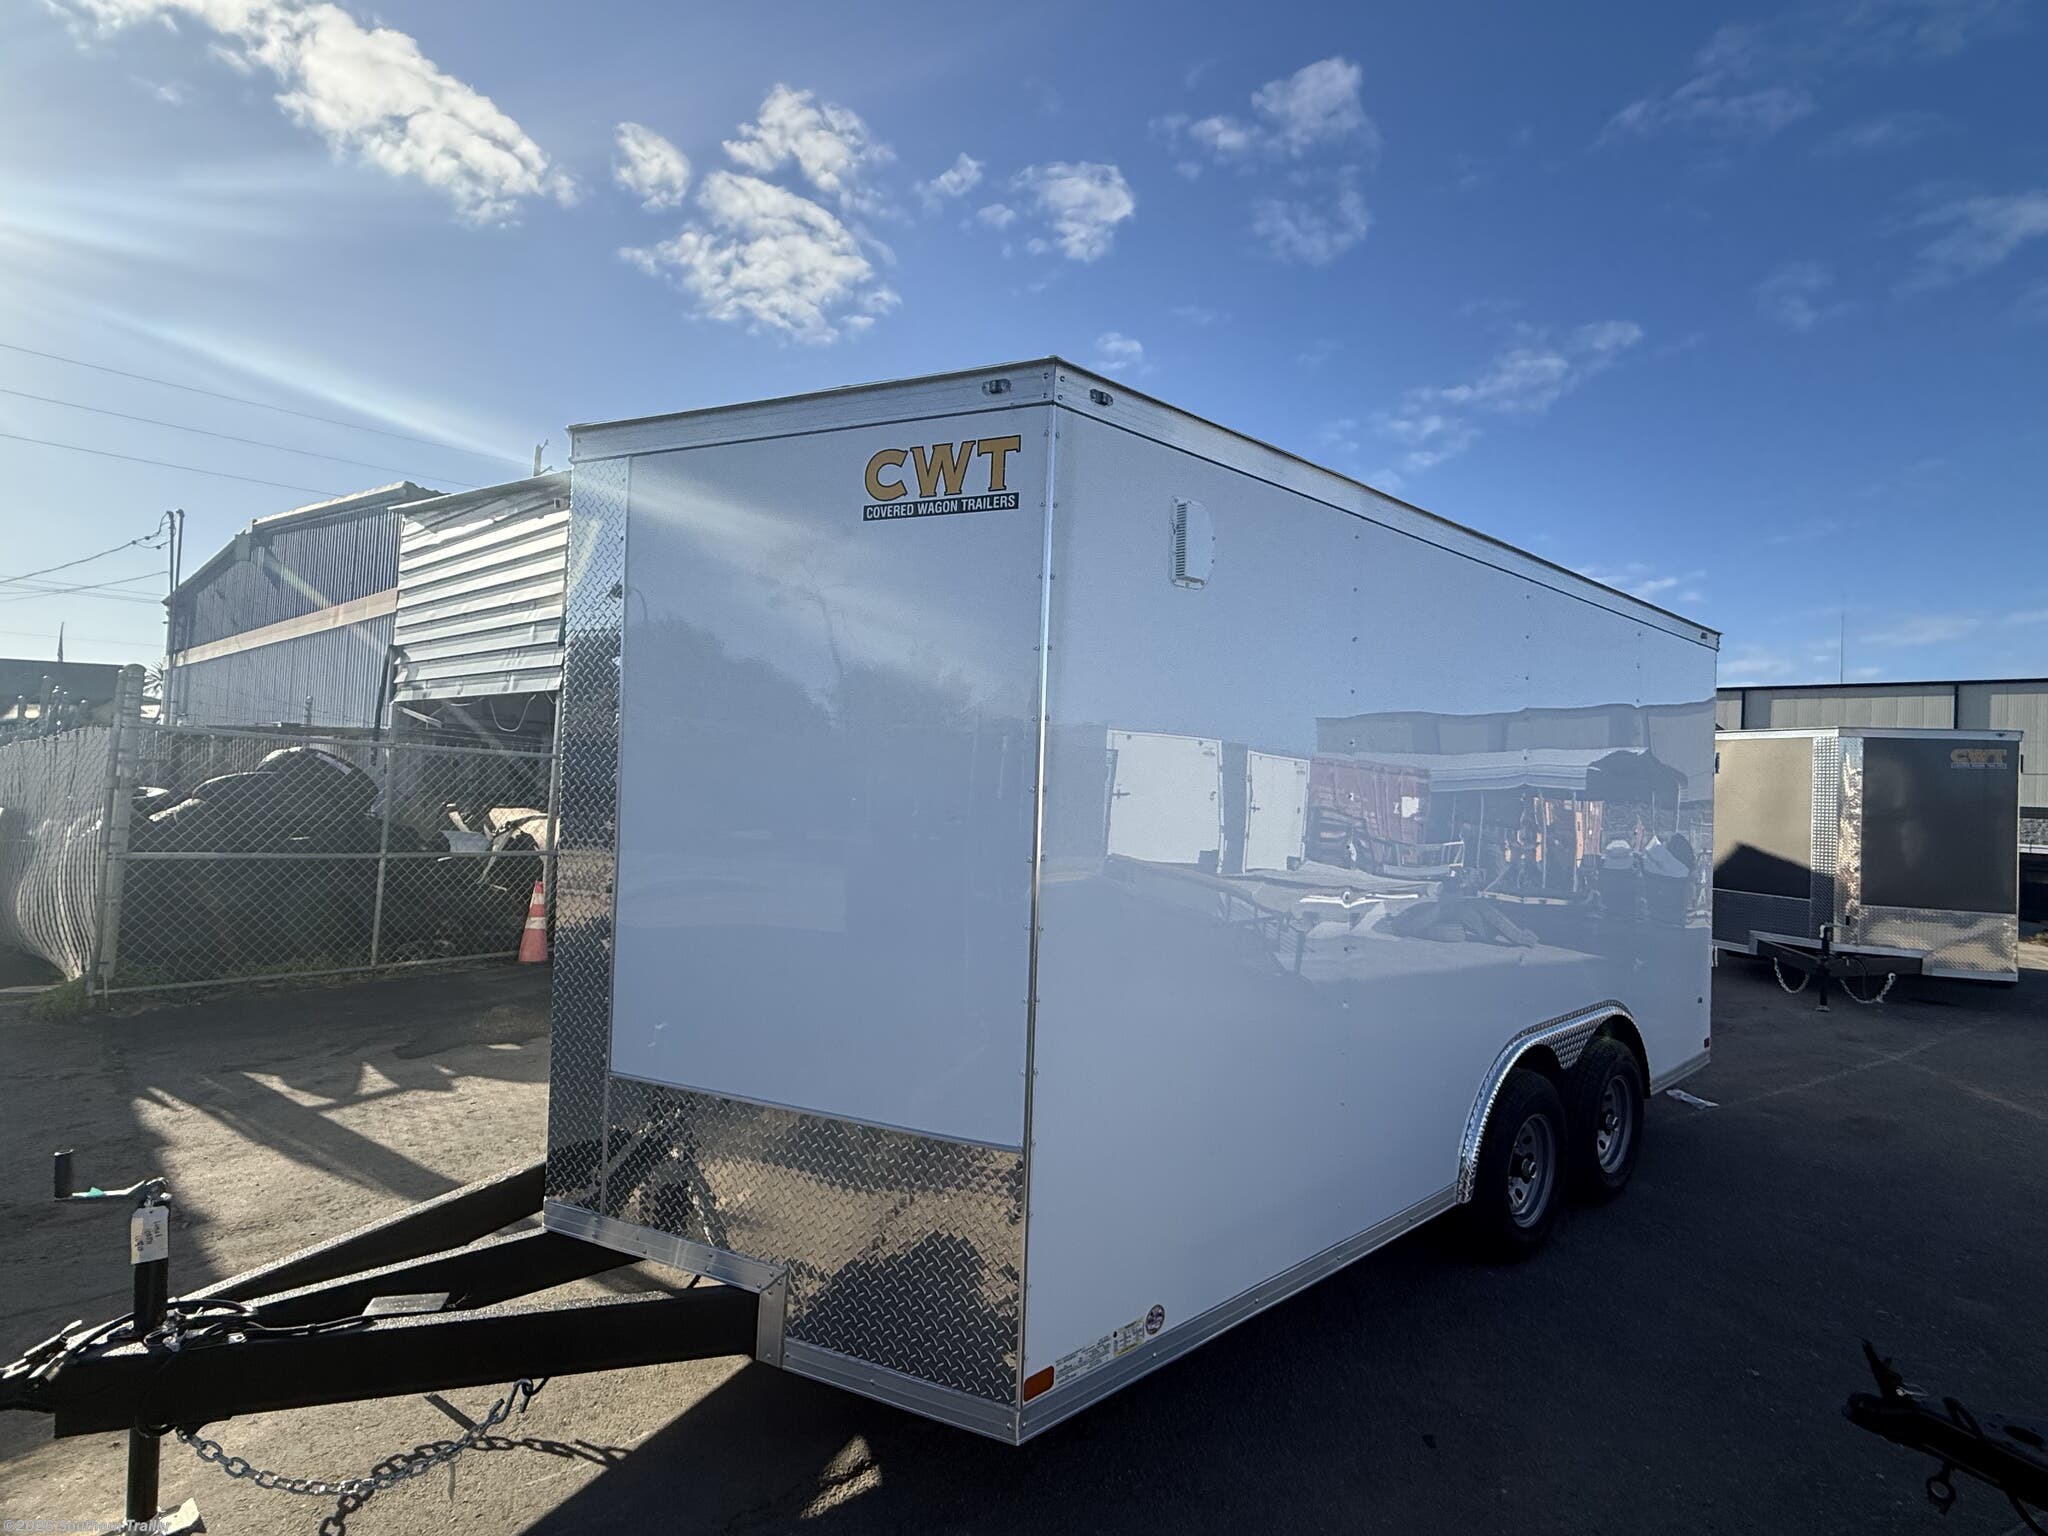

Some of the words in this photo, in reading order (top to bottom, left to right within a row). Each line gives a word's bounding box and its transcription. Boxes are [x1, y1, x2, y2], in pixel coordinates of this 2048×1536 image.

[865, 434, 1021, 501] CWT
[866, 504, 914, 519] COVERED
[917, 500, 958, 515] WAGON
[961, 494, 1016, 511] TRAILERS
[1951, 748, 2007, 763] CWT
